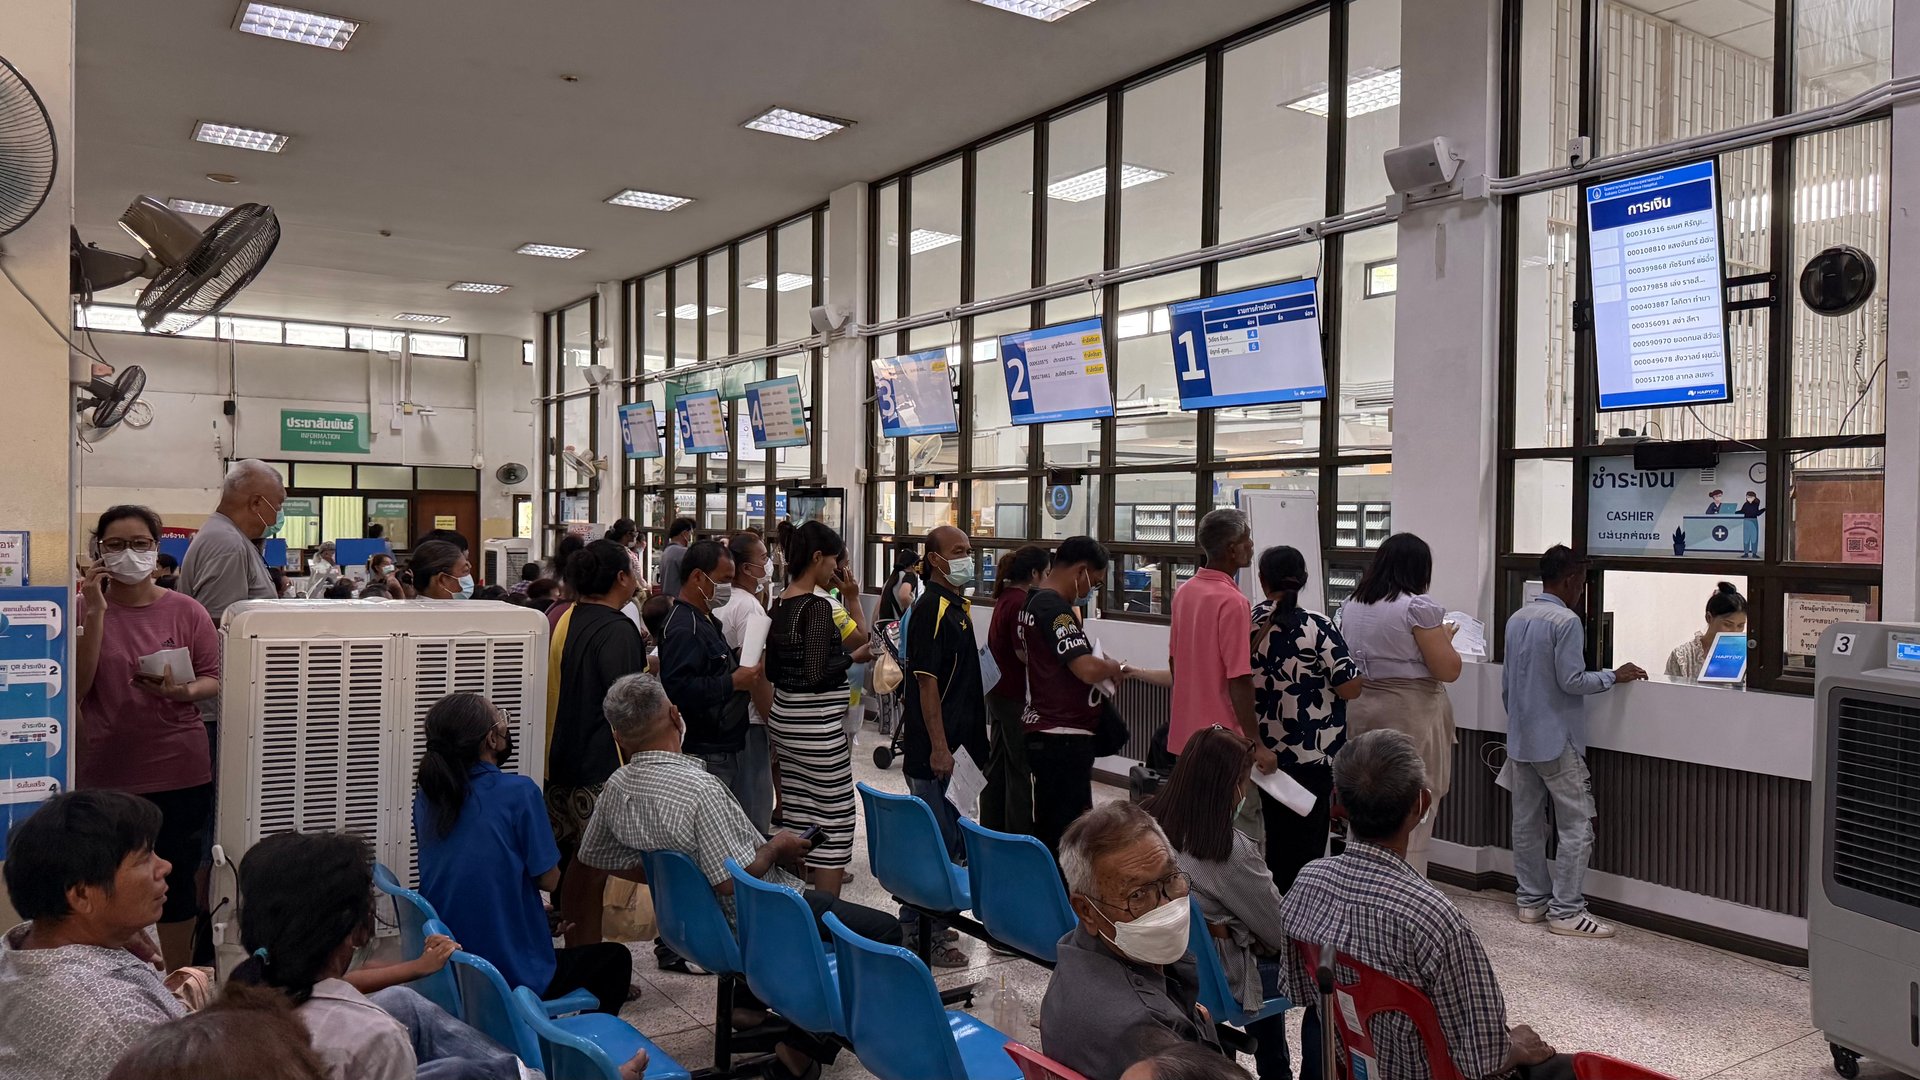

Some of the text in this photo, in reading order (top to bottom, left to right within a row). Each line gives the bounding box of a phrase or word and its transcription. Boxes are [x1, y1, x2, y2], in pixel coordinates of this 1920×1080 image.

[1628, 196, 1671, 215] การเงิน
[1626, 226, 1664, 238] 000316316
[1627, 244, 1666, 256] 000108810
[1628, 263, 1667, 275] 000399868
[1630, 282, 1668, 293] 000379858
[1630, 301, 1669, 312] 000403887
[1632, 319, 1670, 330] 000356091
[1633, 337, 1671, 348] 000590970
[1178, 330, 1206, 380] 1
[1634, 356, 1672, 366] 000049678
[1007, 358, 1029, 400] 2
[1635, 374, 1674, 384] 000517208
[879, 380, 895, 416] 3
[752, 400, 762, 430] 4
[286, 417, 354, 430] ประชาสัมพันธ์
[680, 410, 690, 438] 5
[300, 432, 341, 440] INFORMATION
[622, 419, 631, 445] 6
[1592, 466, 1675, 489] ชำระเงน
[1607, 511, 1654, 521] CASHIER
[50, 608, 56, 617] 1
[1837, 636, 1850, 652] 3
[49, 666, 58, 675] 2
[49, 724, 58, 734] 3
[49, 783, 57, 792] 4
